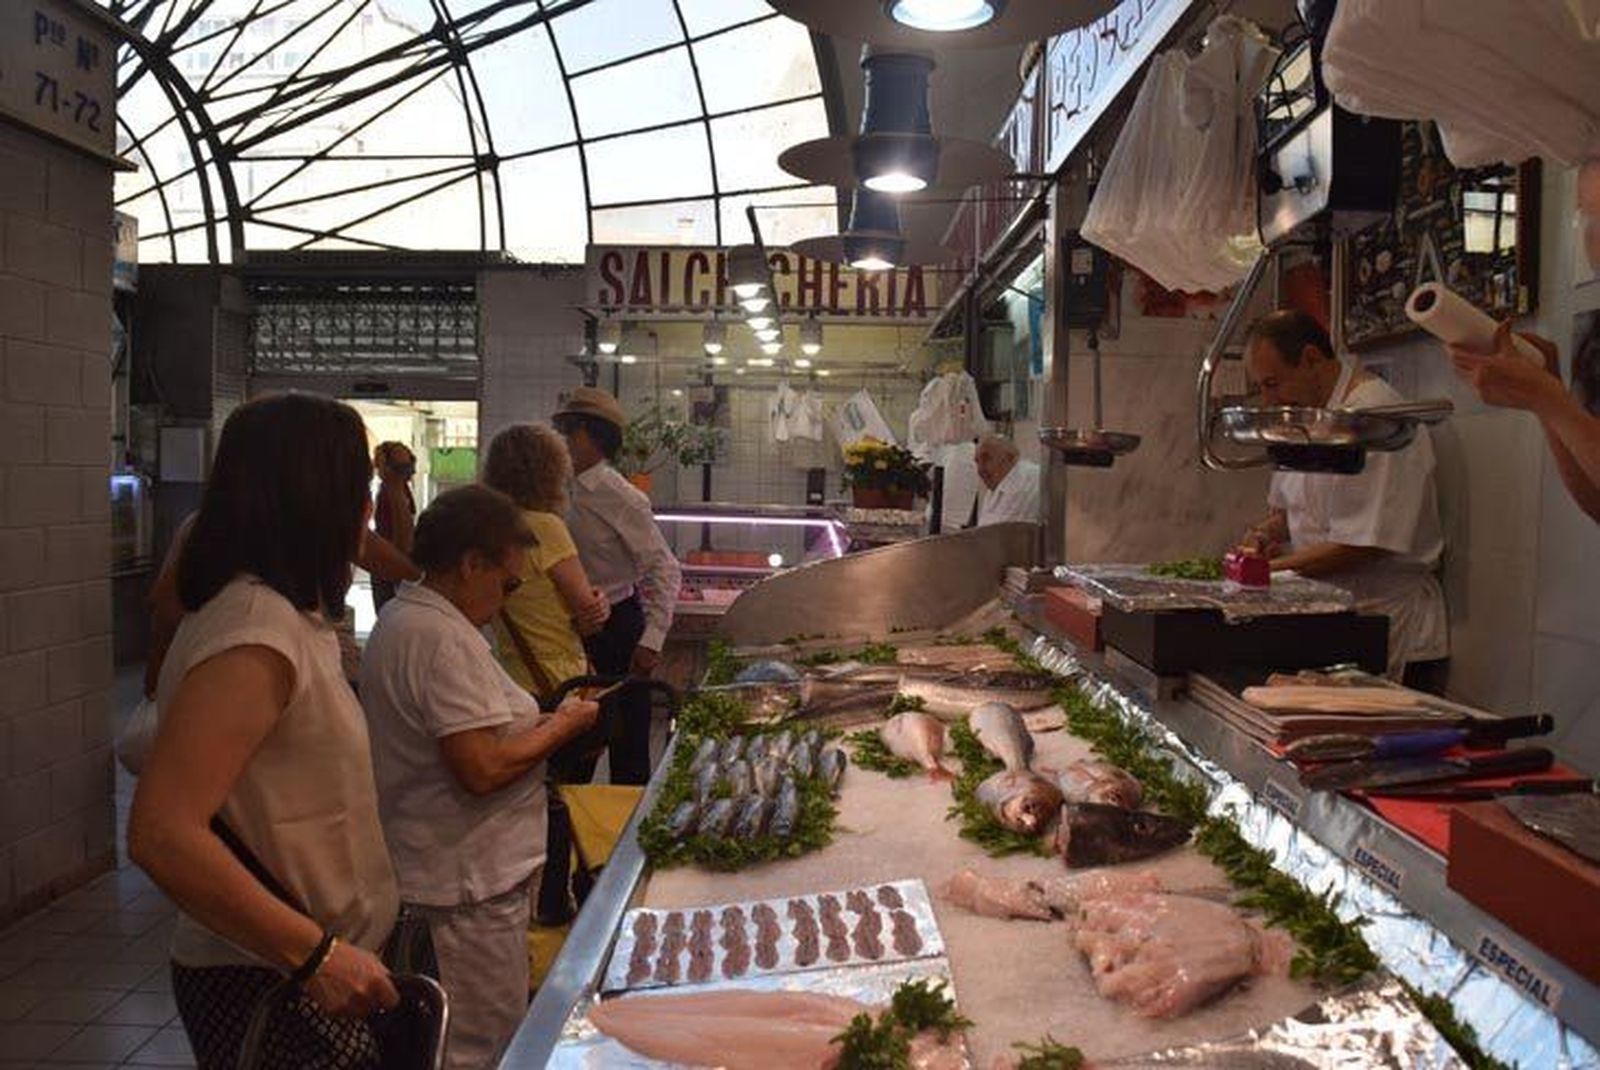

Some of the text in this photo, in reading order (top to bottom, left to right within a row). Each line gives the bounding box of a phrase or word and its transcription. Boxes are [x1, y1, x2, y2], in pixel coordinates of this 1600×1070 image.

[35, 71, 101, 132] 71-72
[598, 250, 927, 317] SALCHCHERIA
[1354, 848, 1401, 890] ESPECIAL
[1478, 937, 1551, 1007] ESPECIAL
